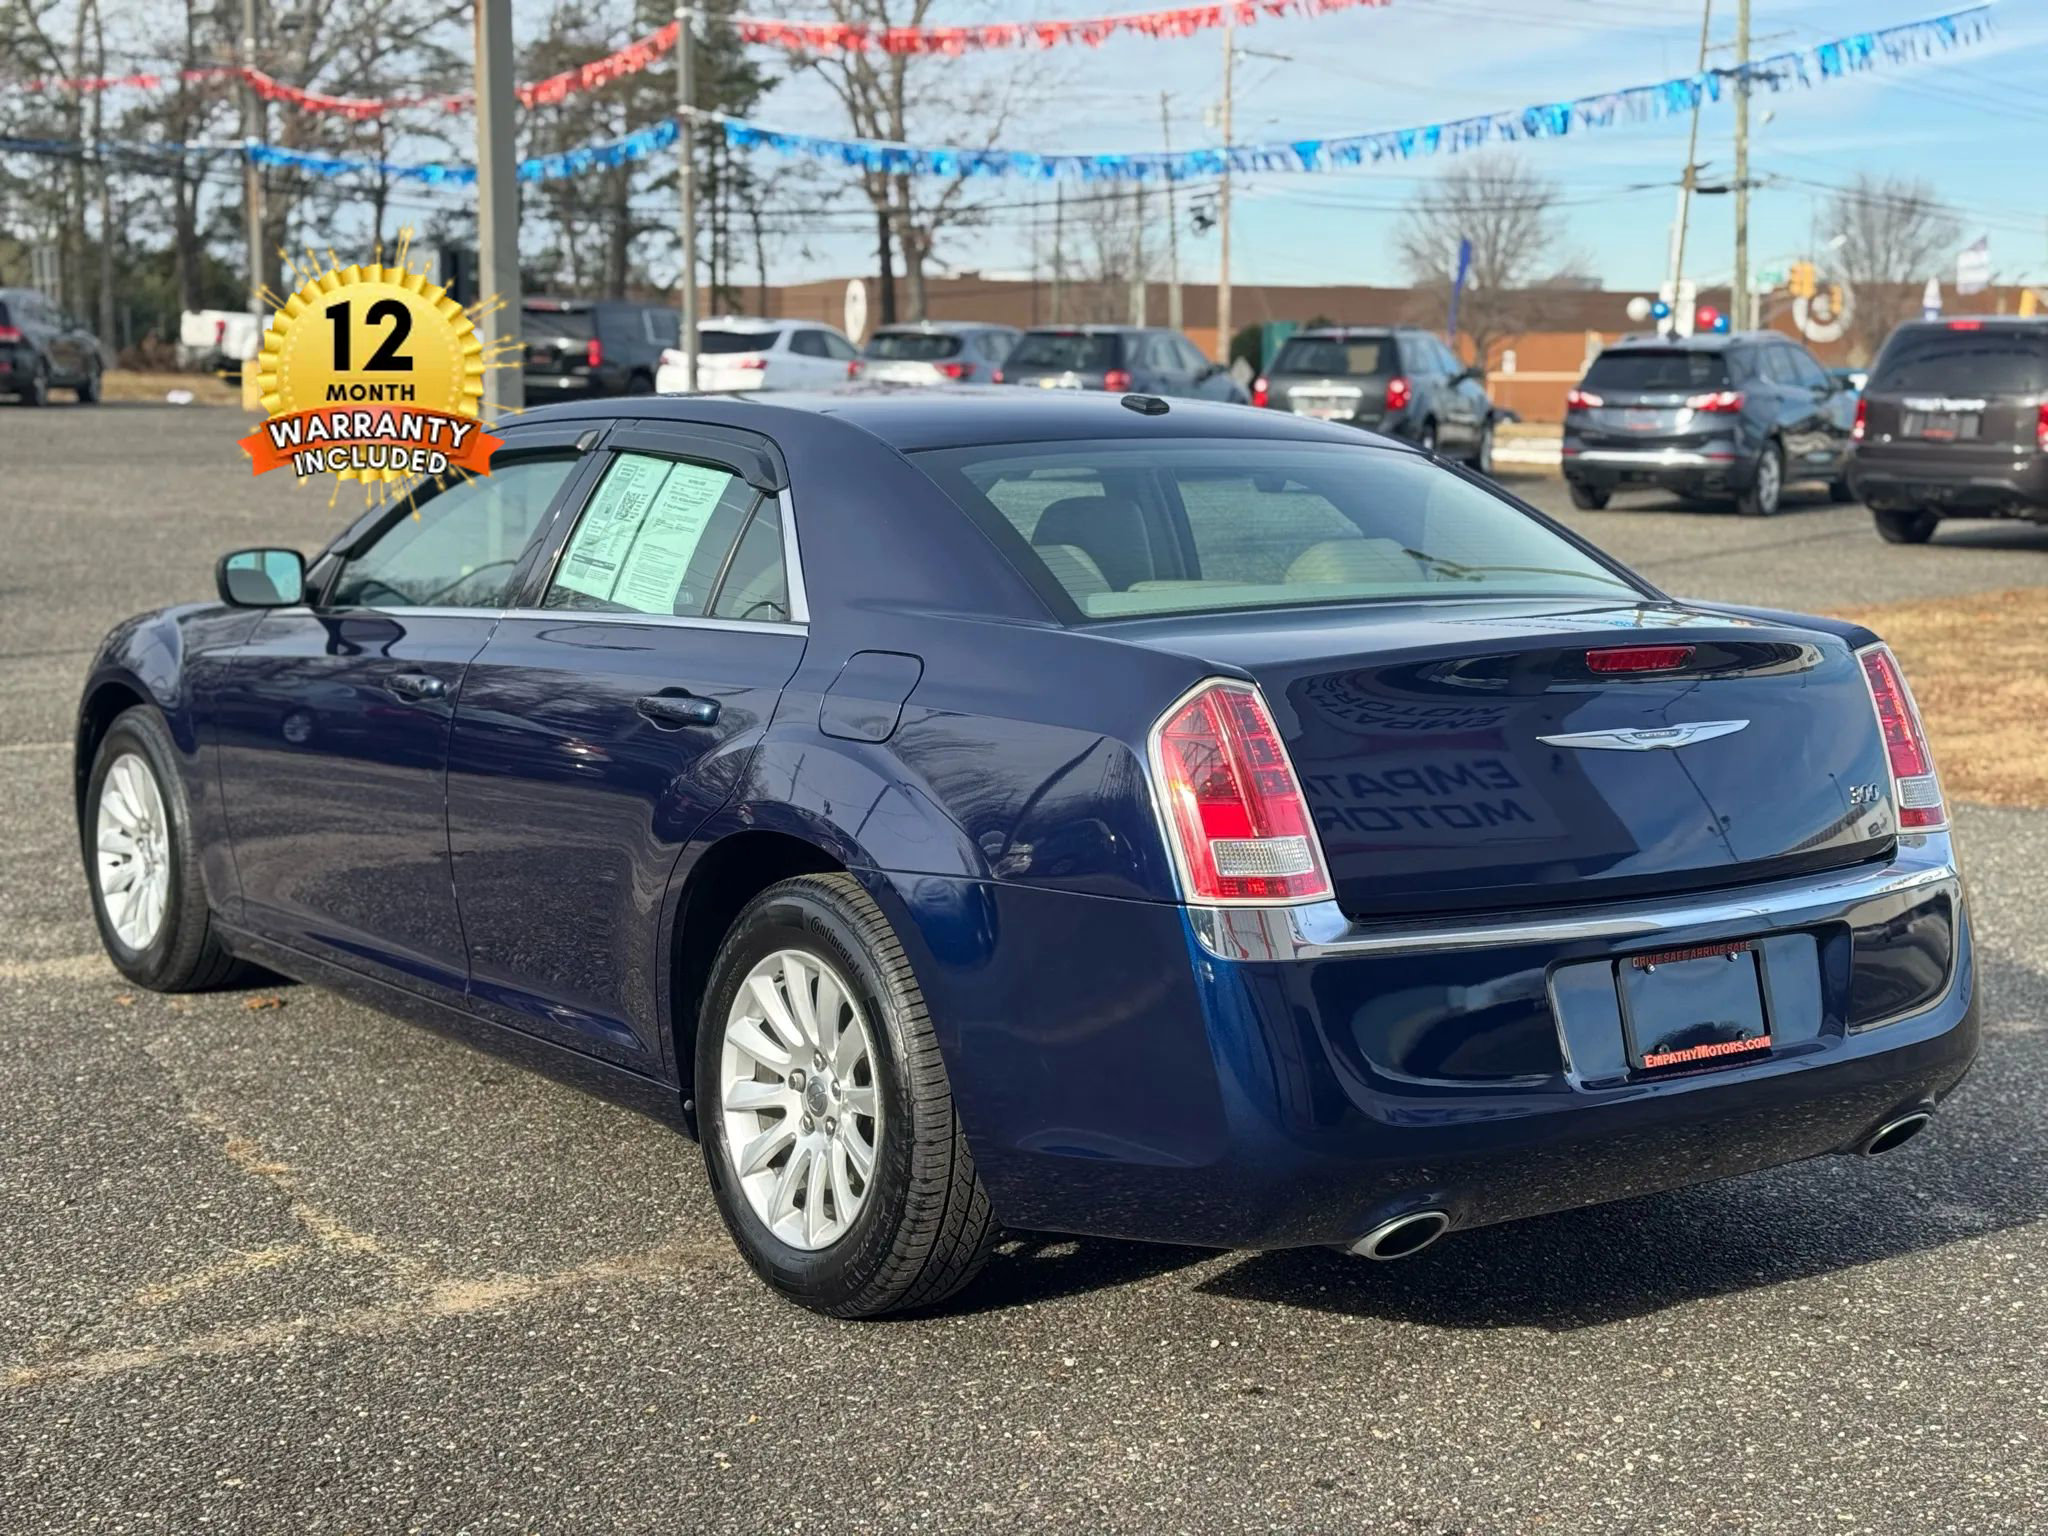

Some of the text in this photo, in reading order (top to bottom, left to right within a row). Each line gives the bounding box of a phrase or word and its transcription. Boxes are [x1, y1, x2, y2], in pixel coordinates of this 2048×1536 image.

[1850, 783, 1879, 803] 300
[810, 915, 860, 977] Continental
[1632, 941, 1751, 968] DRIVE SAFE ARRIVE SAFE
